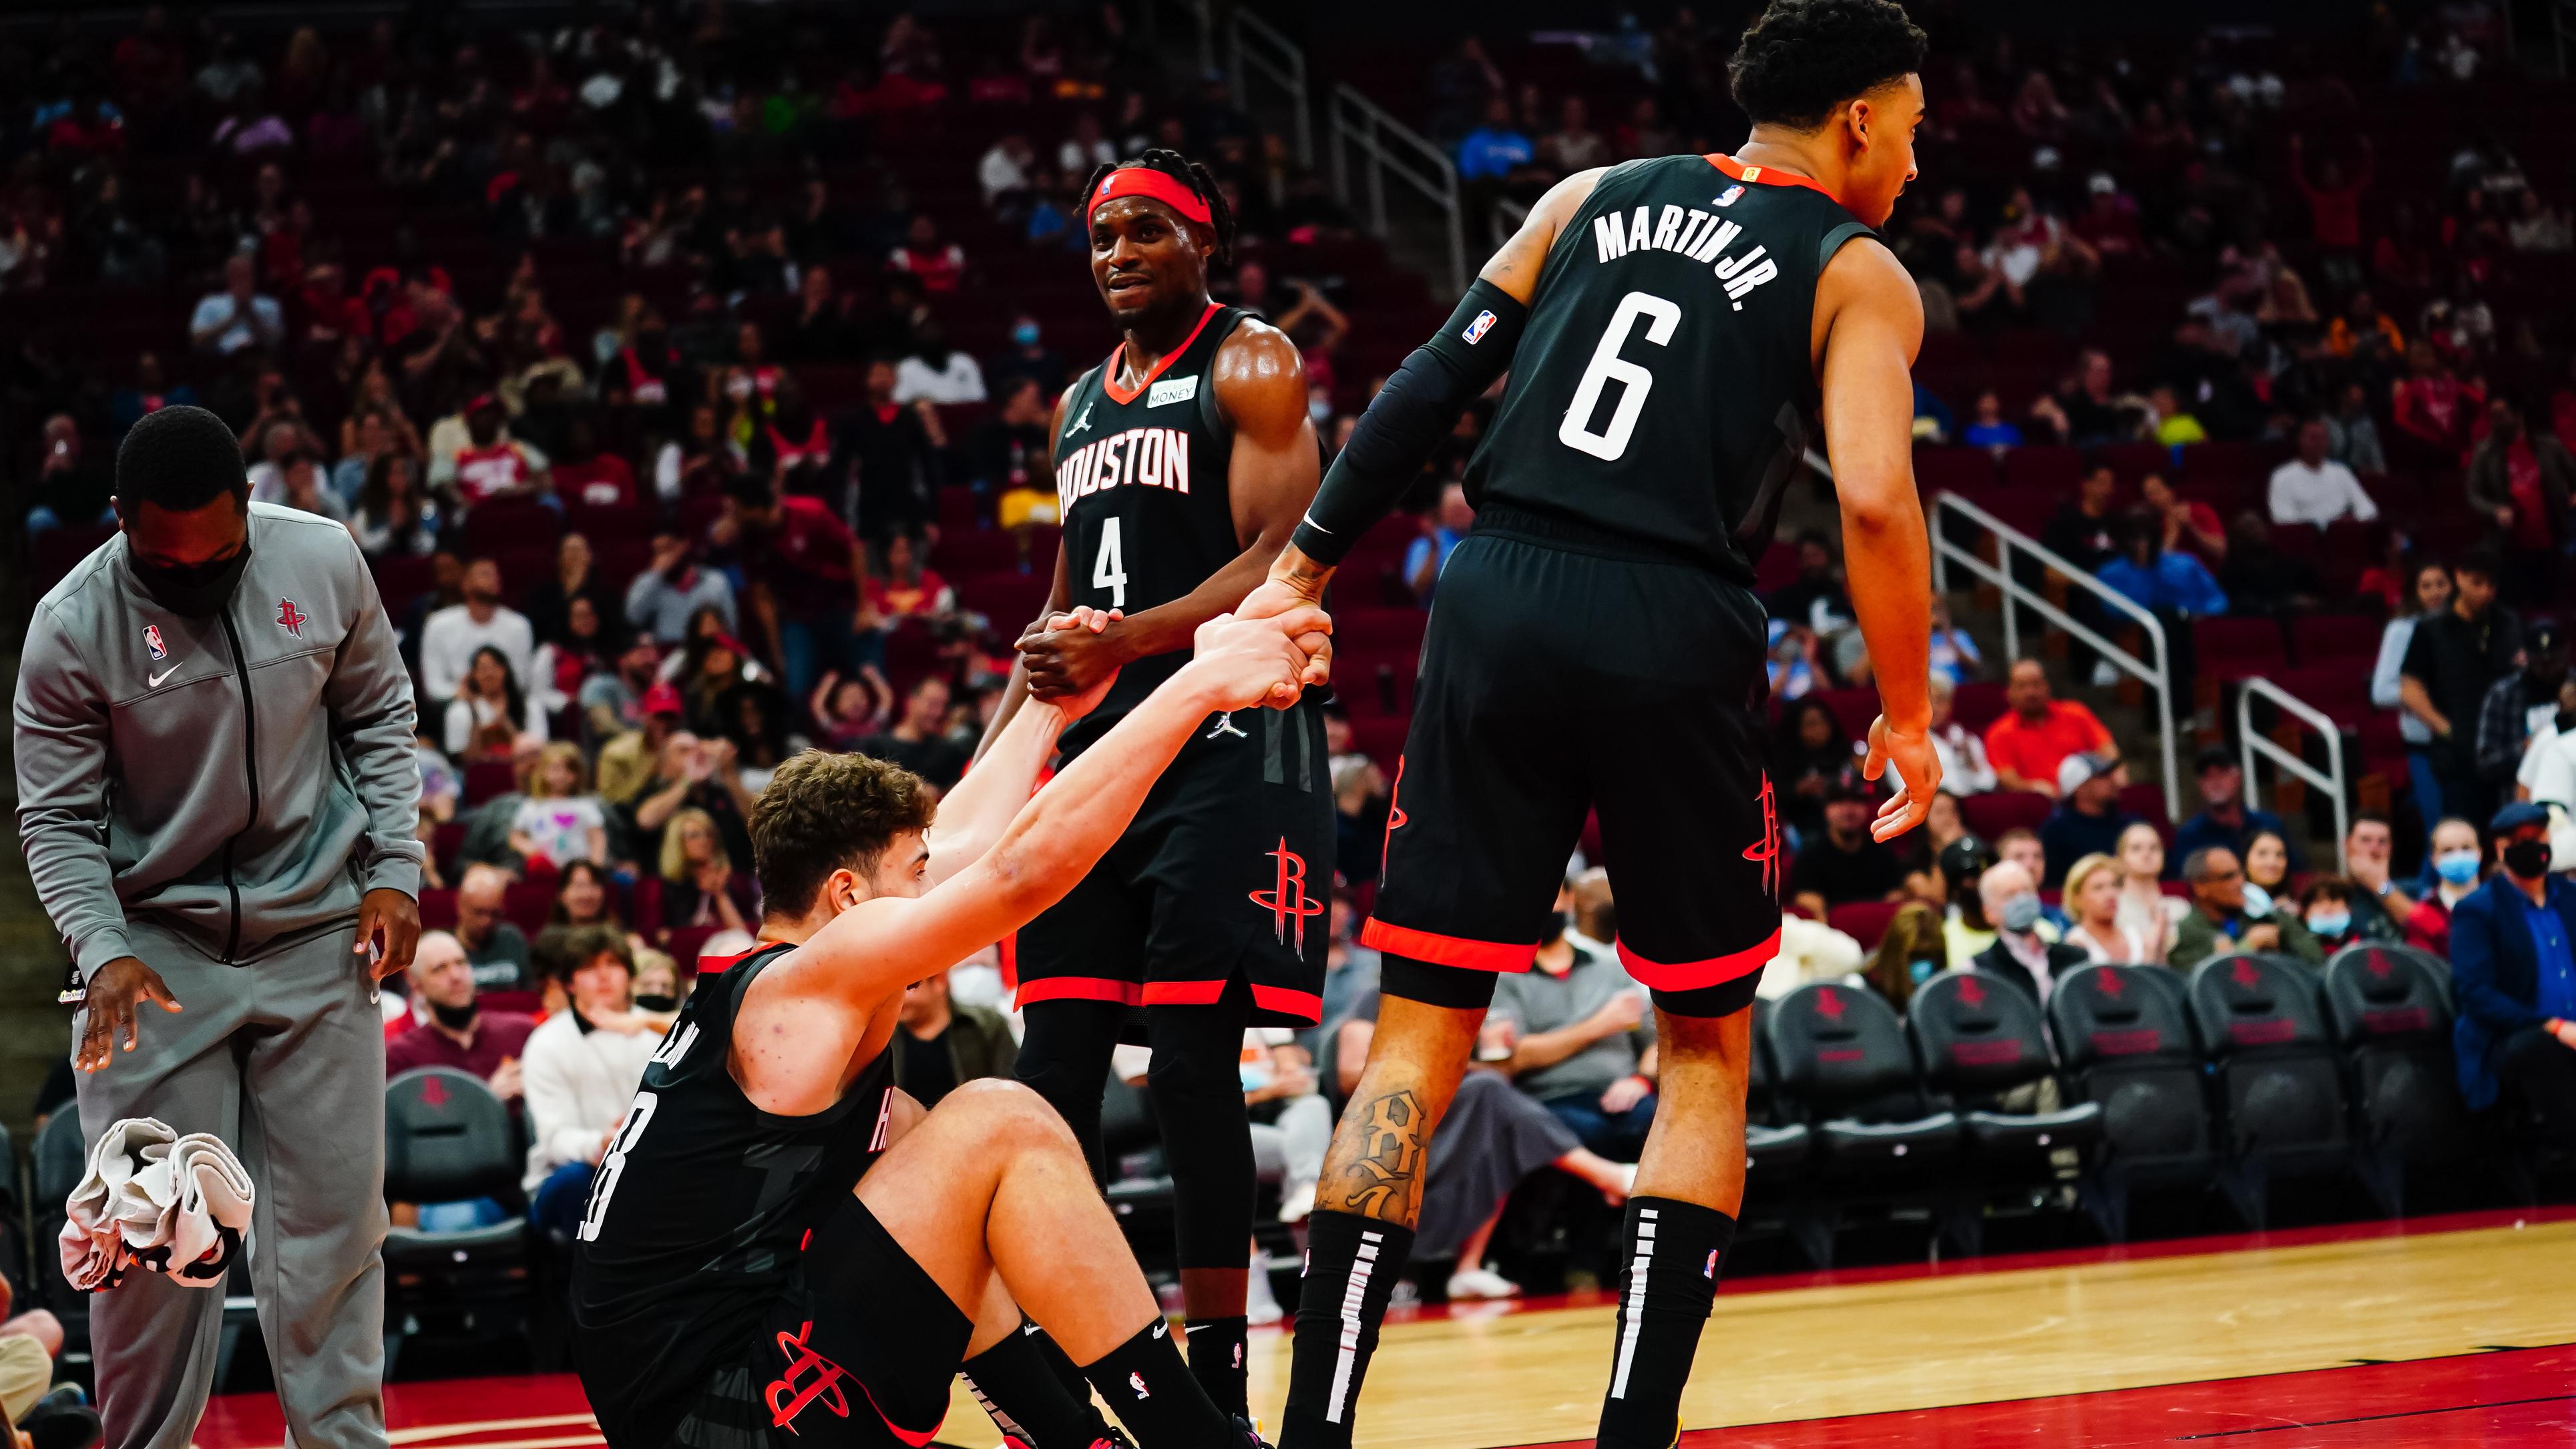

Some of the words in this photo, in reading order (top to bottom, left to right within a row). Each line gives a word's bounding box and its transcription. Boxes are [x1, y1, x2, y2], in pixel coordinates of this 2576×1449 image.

[1594, 204, 1742, 264] MARTIN
[1715, 244, 1778, 312] JR.
[1150, 387, 1194, 405] MONEY
[1558, 291, 1681, 461] 6
[1056, 427, 1190, 528] HOUSTON
[1092, 516, 1127, 608] 4
[576, 1091, 658, 1242] 8
